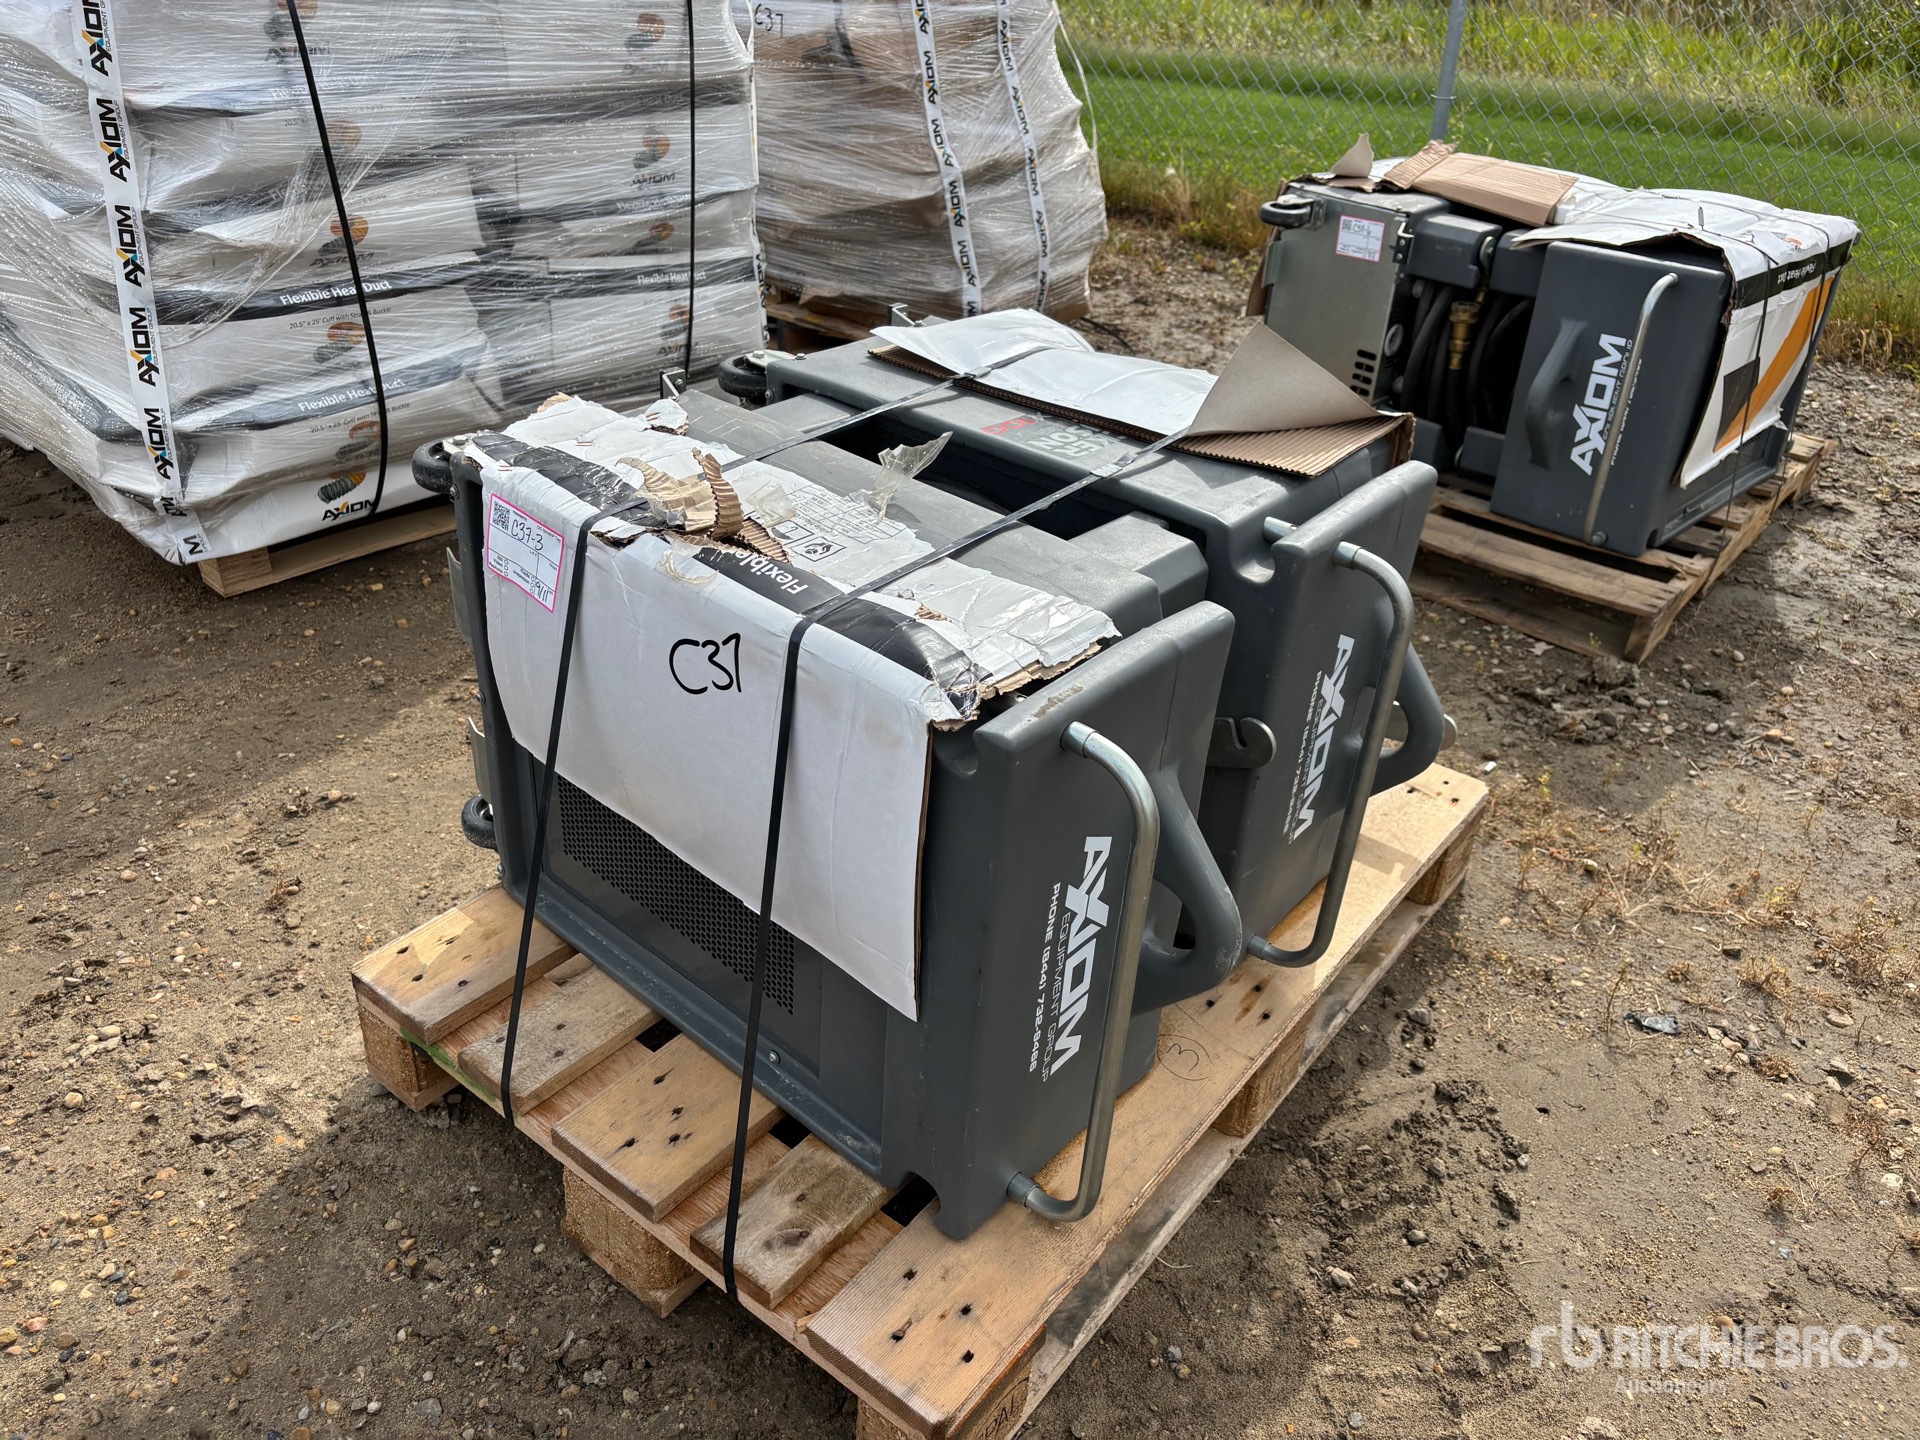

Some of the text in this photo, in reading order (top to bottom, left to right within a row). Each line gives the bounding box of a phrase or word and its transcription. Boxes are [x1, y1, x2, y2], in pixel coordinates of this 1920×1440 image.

[101, 10, 111, 51] EQUIPMENT
[754, 3, 784, 38] C37
[1000, 20, 1014, 71] AXIOM
[924, 51, 938, 105] AXIOM
[1012, 85, 1029, 135] AXIOM
[96, 98, 131, 183] AXIOM
[119, 124, 130, 160] EQUIPMENT
[1028, 148, 1040, 196] AXIOM
[948, 180, 966, 228] AXIOM
[114, 205, 145, 288] AXIOM
[131, 207, 145, 266] EQUIPMENT GROUP
[1036, 210, 1049, 258] AXIOM
[957, 240, 977, 287] AXIOM
[280, 280, 393, 306] Flexible Hea Duct
[335, 313, 349, 321] with
[350, 311, 363, 319] Stra
[373, 306, 392, 315] Buckle
[129, 307, 160, 387] AXIOM
[150, 331, 159, 365] EQUIPMENT
[298, 392, 347, 412] Flexible
[347, 386, 377, 400] Heat
[1570, 333, 1627, 476] AXIOM
[144, 408, 173, 480] AXIOM
[511, 519, 544, 551] C37-3
[735, 550, 810, 595] Flexible
[669, 632, 742, 695] C37
[1306, 670, 1323, 723] PHONE
[1293, 634, 1355, 840] AXIOM
[1288, 698, 1324, 845] EQUIPMENT GROUP
[1044, 882, 1061, 943] PHONE
[1038, 946, 1051, 991] (844)
[1050, 836, 1112, 1076] AXIOM
[1042, 912, 1071, 1082] EQUIPMENT GROUP
